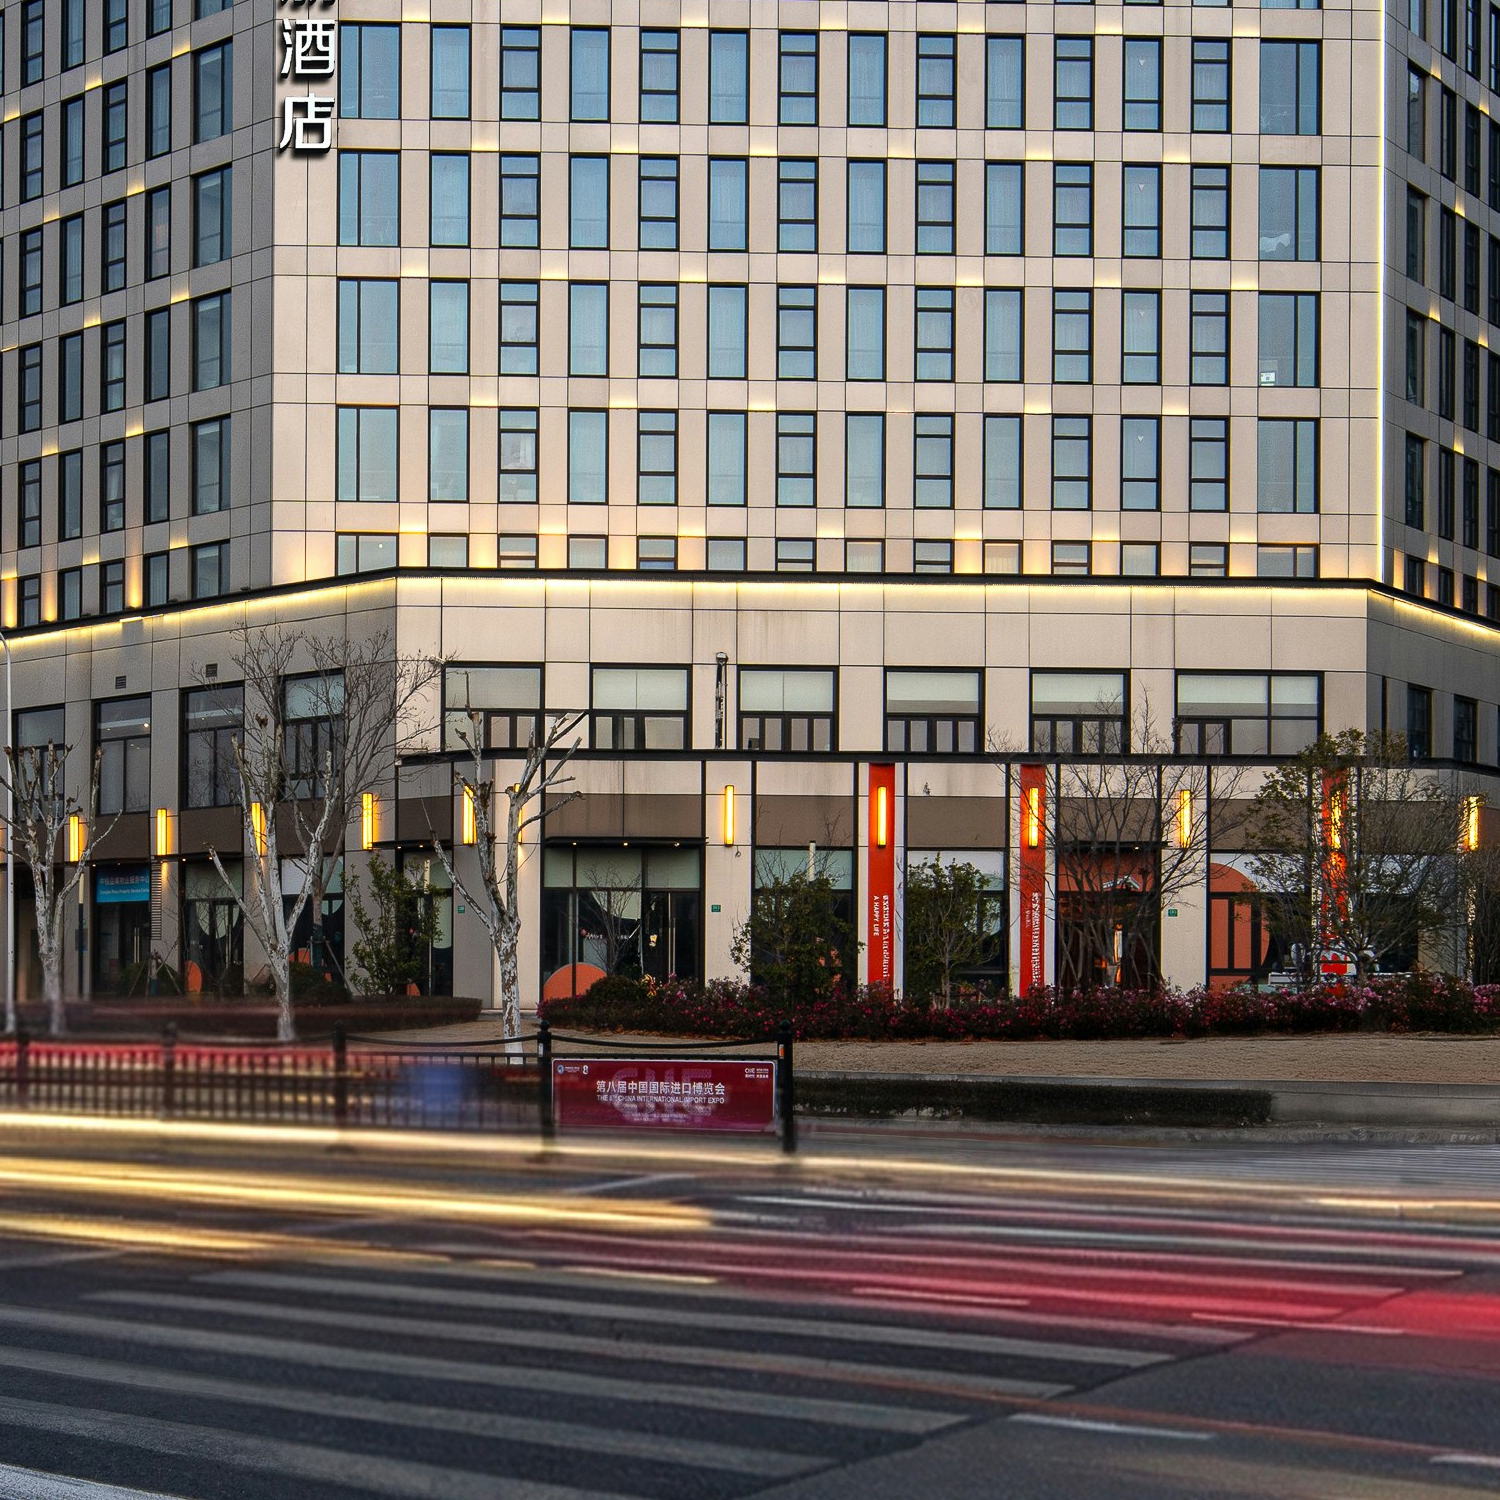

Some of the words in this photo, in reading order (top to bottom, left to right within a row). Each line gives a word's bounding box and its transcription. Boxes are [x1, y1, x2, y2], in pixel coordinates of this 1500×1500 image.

[596, 1080, 726, 1096] 第八届中国国际进口博览会
